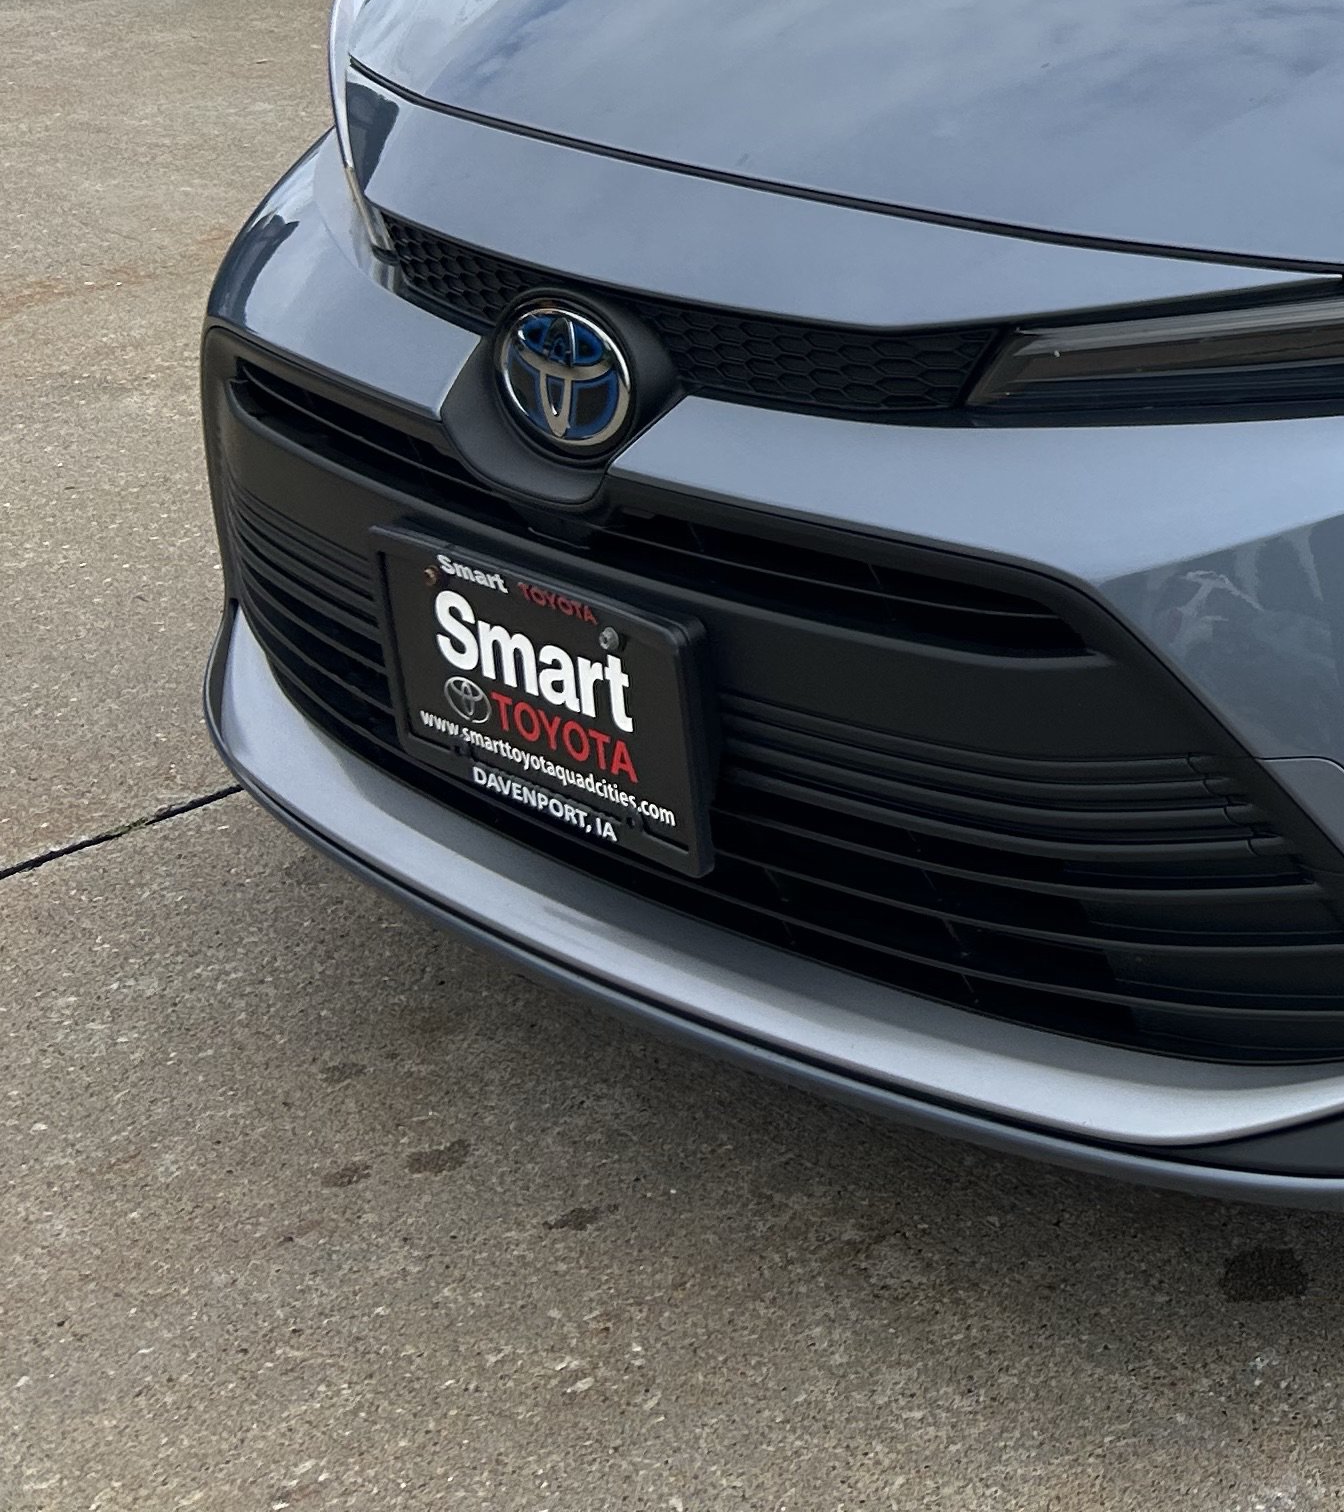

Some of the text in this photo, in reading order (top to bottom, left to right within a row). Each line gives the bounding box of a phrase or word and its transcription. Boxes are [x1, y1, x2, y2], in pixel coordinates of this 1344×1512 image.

[436, 553, 598, 625] Smart TOYOTA
[435, 590, 634, 733] Smart
[419, 709, 676, 827] www.smarttoyotaquadcities.com
[490, 691, 639, 784] TOYOTA
[473, 766, 618, 842] DAVENPORT, IA
